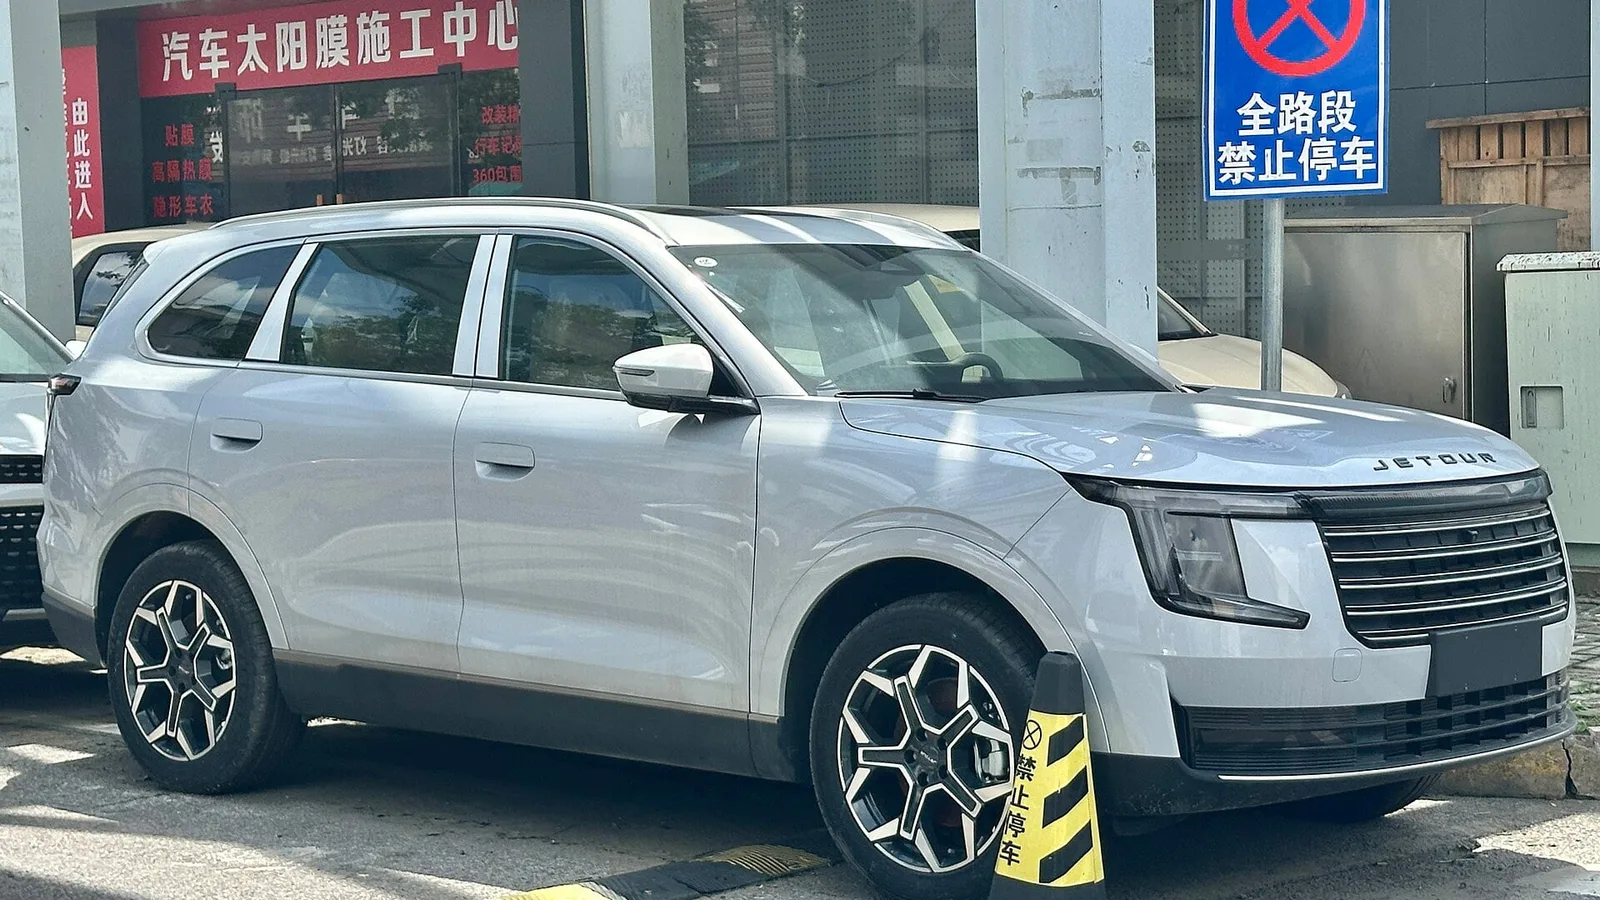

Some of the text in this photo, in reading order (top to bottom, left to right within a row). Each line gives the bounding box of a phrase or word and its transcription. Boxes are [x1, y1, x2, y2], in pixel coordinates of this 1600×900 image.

[162, 0, 518, 82] 汽车太阳膜施工中心
[165, 123, 195, 146] 贴膜
[1237, 90, 1356, 136] 全路段
[72, 97, 93, 220] 由此进入
[152, 158, 213, 182] 高隔热膜
[1217, 136, 1376, 185] 禁止停车
[153, 194, 214, 217] 隐形车衣
[1373, 452, 1498, 471] JETOUR
[1000, 754, 1037, 866] 禁止停车
